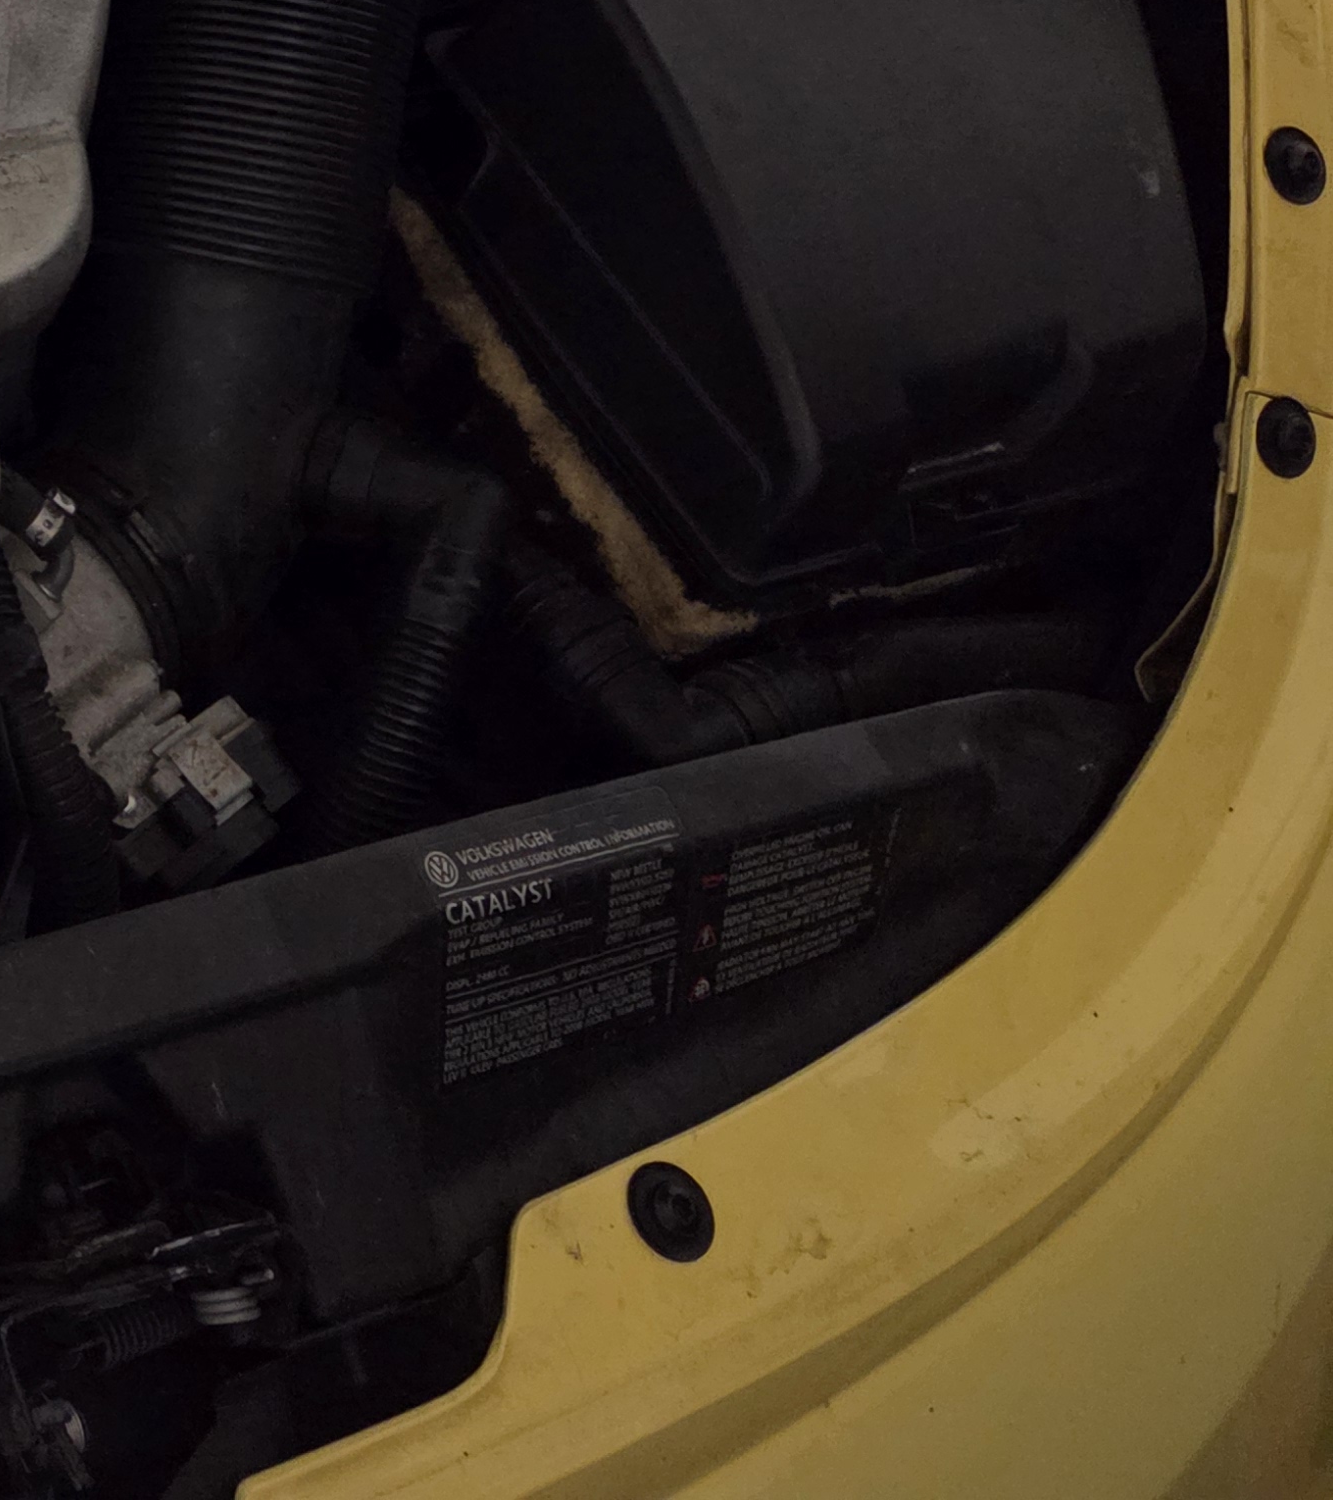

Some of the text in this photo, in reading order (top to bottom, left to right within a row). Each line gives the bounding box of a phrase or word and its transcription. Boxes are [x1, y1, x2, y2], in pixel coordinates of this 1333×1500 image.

[454, 828, 554, 866] VOLKSWAGEN
[466, 819, 675, 882] VEHICLE EMISSION CONTROL INFORMATION
[425, 851, 459, 888] VW
[445, 878, 553, 925] CATALYST
